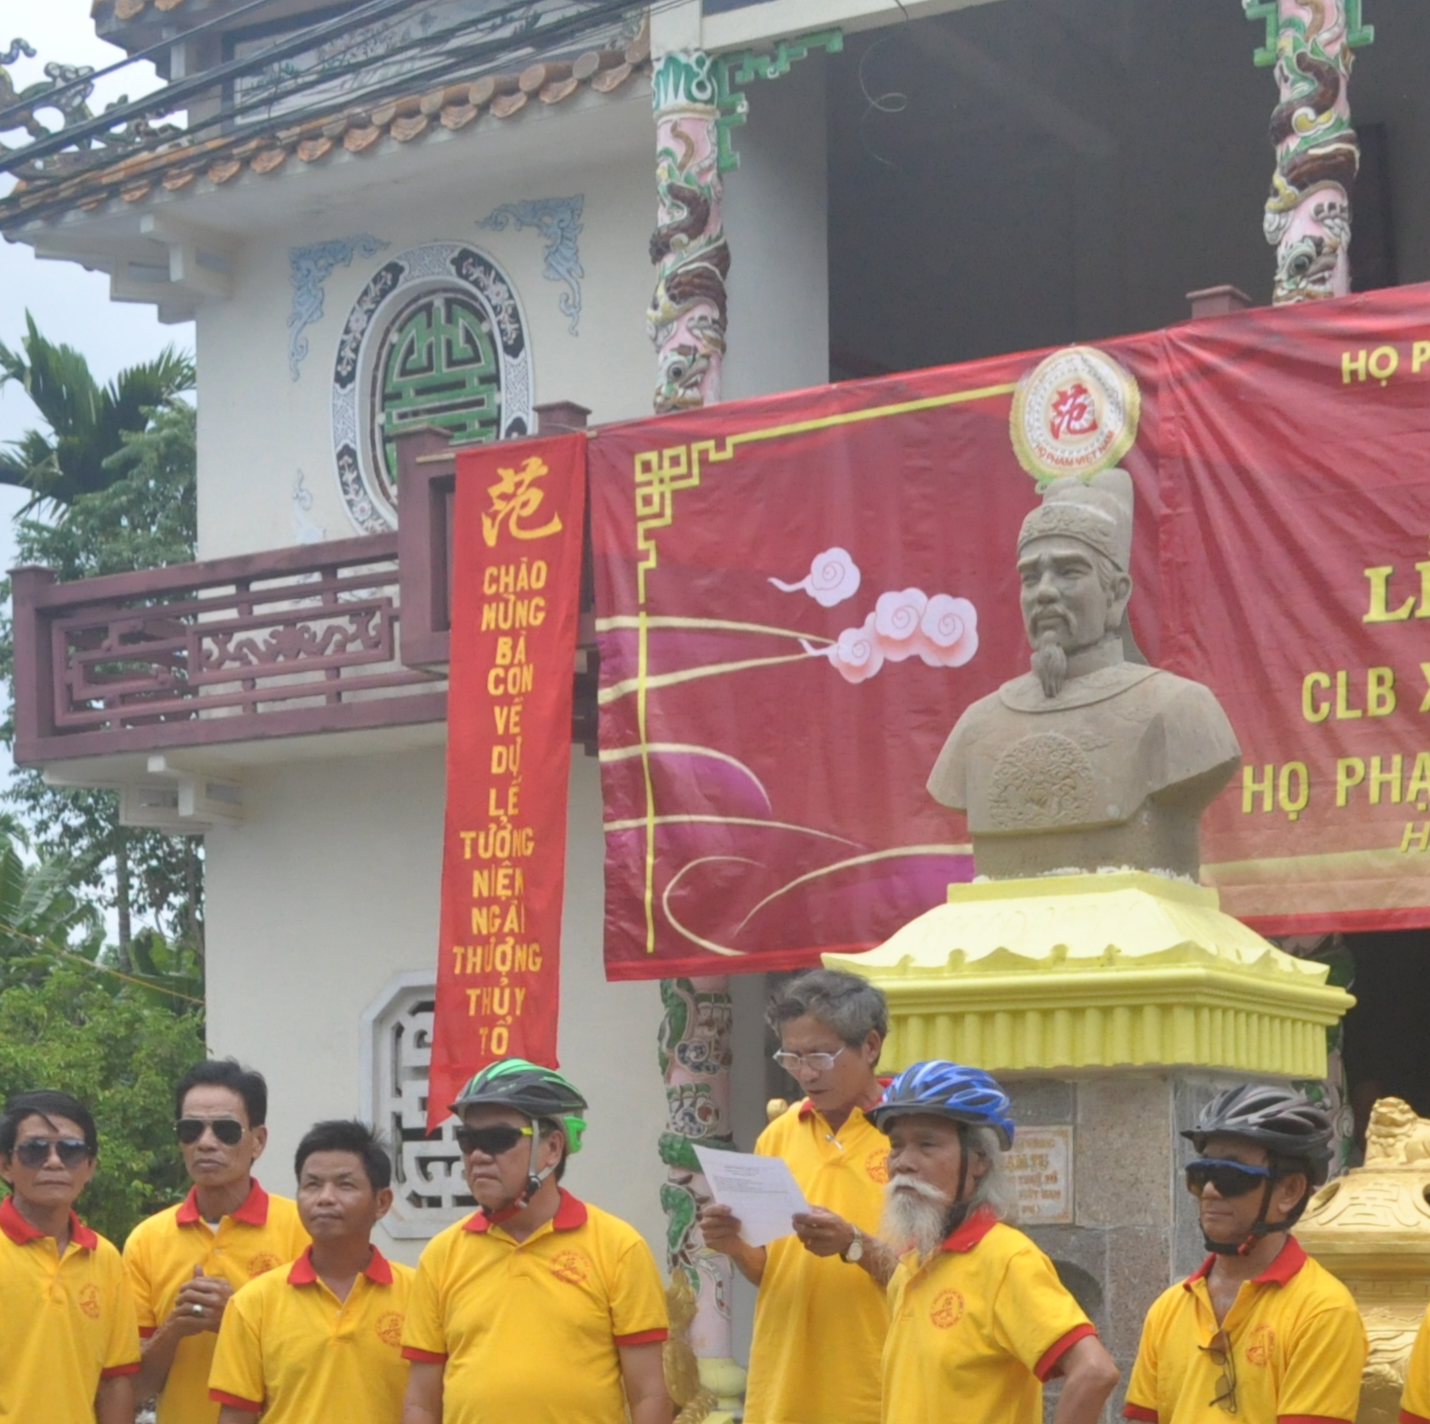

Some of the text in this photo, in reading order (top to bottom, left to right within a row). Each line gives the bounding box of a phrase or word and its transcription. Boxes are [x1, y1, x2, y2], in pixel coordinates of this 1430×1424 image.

[1341, 344, 1398, 387] HỌ
[481, 456, 563, 547] 范
[483, 557, 548, 595] CHÀO
[495, 630, 526, 666] BÀ
[487, 664, 534, 696] CON
[1301, 667, 1396, 723] CLB
[490, 736, 522, 777] DỰ
[1242, 759, 1311, 820] HỌ
[460, 814, 534, 860] TƯỞNG
[479, 1014, 512, 1055] TỔ
